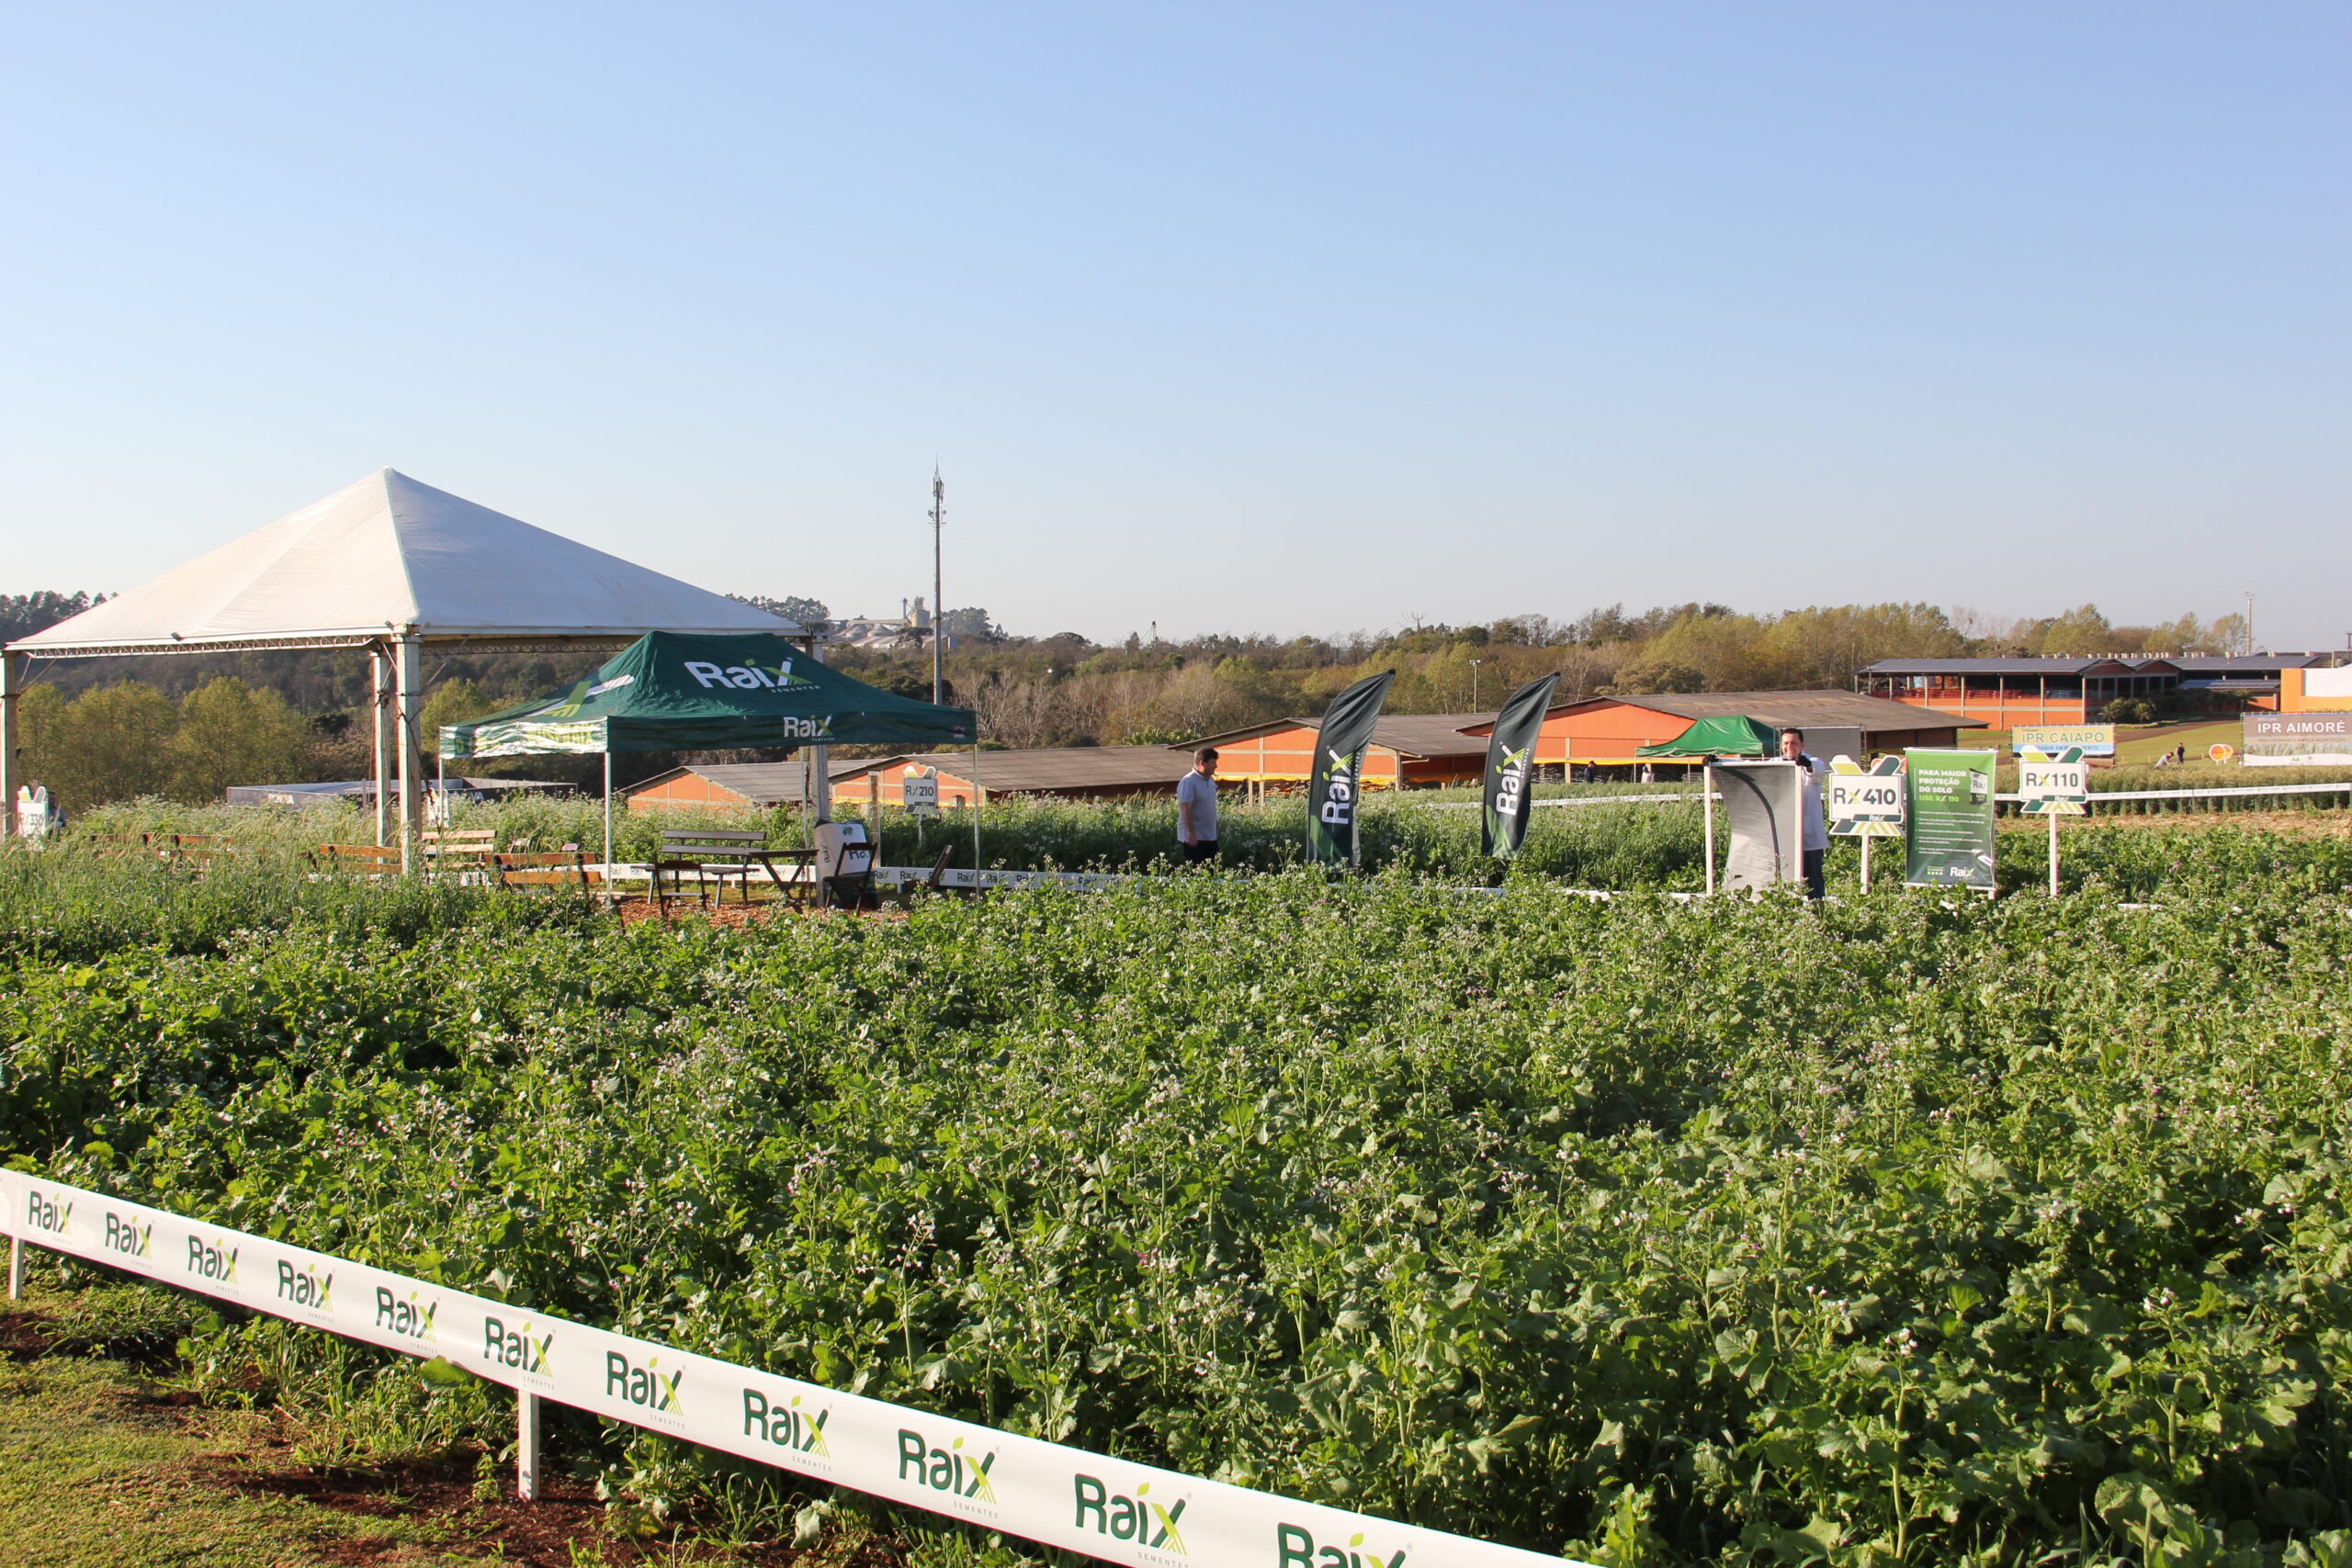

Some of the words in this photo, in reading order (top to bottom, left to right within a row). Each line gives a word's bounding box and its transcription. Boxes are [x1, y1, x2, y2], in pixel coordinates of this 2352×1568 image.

[684, 657, 813, 689] Raix
[783, 715, 833, 738] Raix
[2021, 733, 2044, 743] IPR
[2257, 723, 2281, 734] IPR
[2286, 720, 2346, 733] AIMORÉ
[1322, 749, 1353, 825] Raix
[1496, 745, 1526, 816] Raix
[1918, 777, 1960, 786] PROTEÇÃO
[899, 871, 917, 881] Raix
[957, 873, 975, 883] Raix
[1949, 866, 1975, 877] Raix
[28, 1190, 74, 1235] Raix
[105, 1212, 153, 1259] Raix
[188, 1234, 240, 1285] Raix
[277, 1258, 334, 1313] Raix
[376, 1286, 437, 1343] Raix
[484, 1315, 553, 1378] Raix
[523, 1376, 555, 1391] SEMENTES
[606, 1350, 684, 1416] Raix
[650, 1414, 685, 1429] SEMENTES
[742, 1387, 831, 1459] Raix
[792, 1455, 832, 1472] SEMENTES
[898, 1428, 997, 1505] Raix
[953, 1500, 1000, 1519] SEMENTES
[1074, 1472, 1189, 1556] Raix
